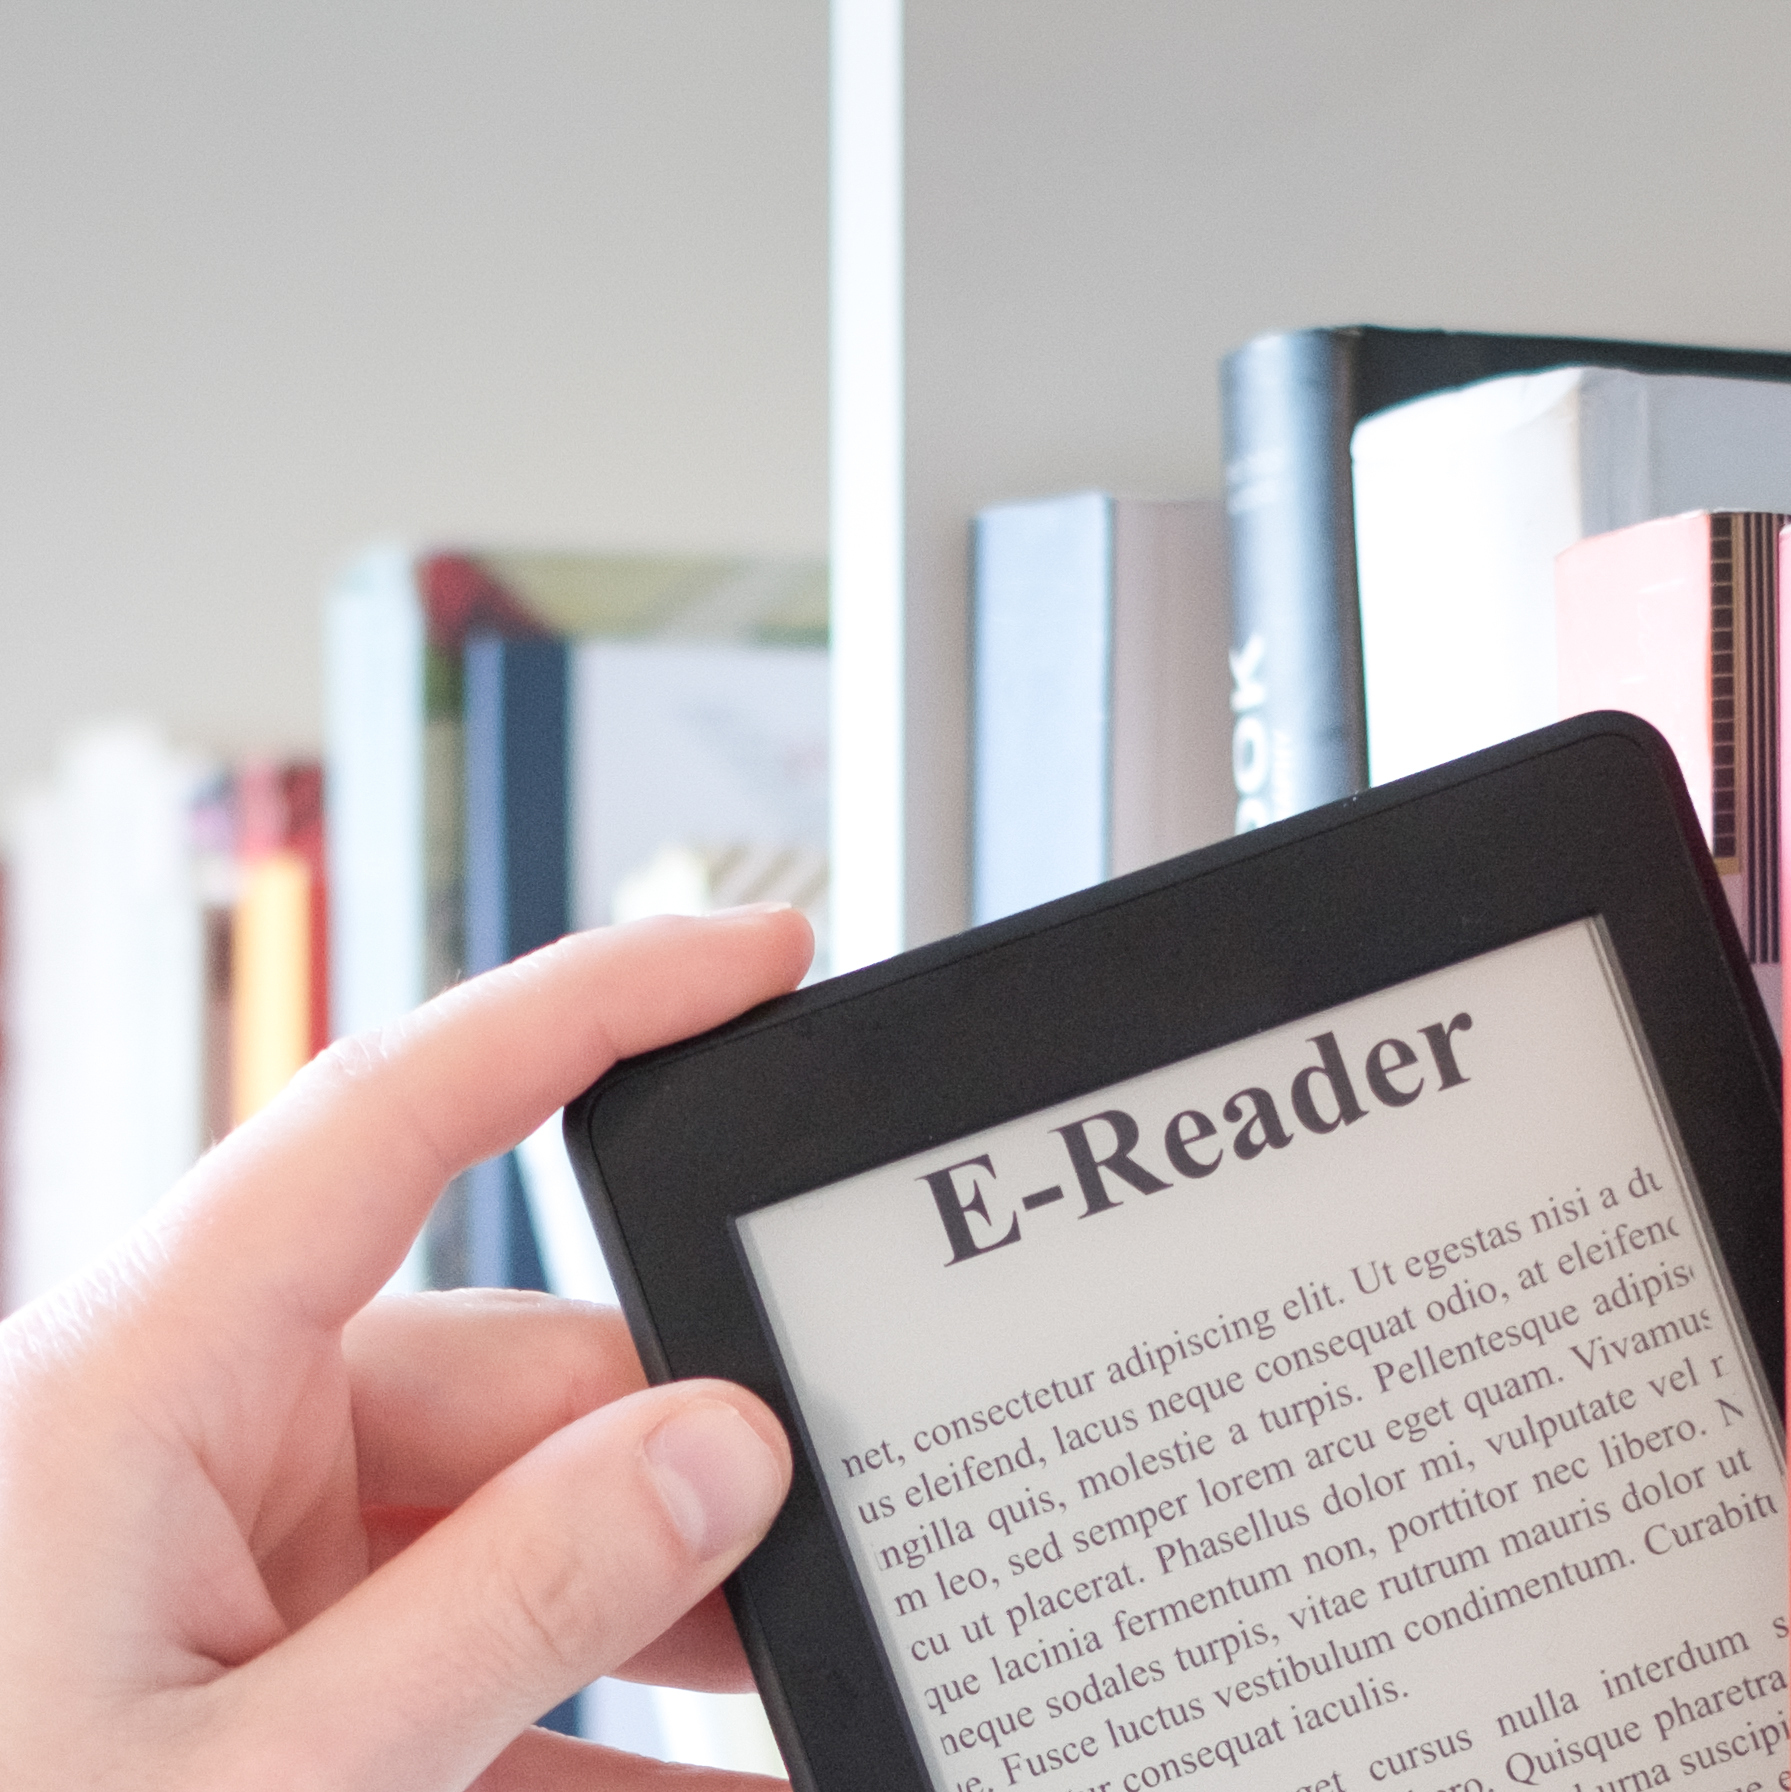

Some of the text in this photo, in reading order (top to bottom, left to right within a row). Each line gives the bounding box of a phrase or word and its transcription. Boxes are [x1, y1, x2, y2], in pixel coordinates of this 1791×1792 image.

[917, 1011, 1474, 1268] E-Reader
[857, 1495, 896, 1525] us
[905, 1436, 1047, 1508] eleifend,
[1052, 1409, 1139, 1455] lacus
[1147, 1371, 1244, 1422] neque
[1255, 1307, 1417, 1383] consequat
[1426, 1279, 1510, 1322] odio,
[1518, 1261, 1548, 1291] at
[870, 1262, 1695, 1573] ngilla quis, molestie a turpis. Pellentesque adipis
[913, 1370, 1095, 1453] consectetur
[1106, 1309, 1276, 1385] adipiscing
[1282, 1281, 1345, 1321] elit.
[1351, 1261, 1396, 1295] Ut
[1404, 1221, 1522, 1280] egestas
[1530, 1187, 1590, 1234] nisi
[1599, 1187, 1619, 1210] a
[894, 1588, 928, 1616] m
[934, 1567, 1000, 1601] leo,
[1008, 1530, 1064, 1576] sed
[1072, 1493, 1188, 1553] semper
[1197, 1458, 1295, 1507] lorem
[1305, 1429, 1376, 1471] arcu
[1385, 1398, 1454, 1443] eget
[1463, 1366, 1564, 1419] quam.
[910, 1633, 951, 1662] cu
[961, 1613, 995, 1644] ut
[1005, 1563, 1145, 1637] placerat.
[1155, 1504, 1311, 1575] Phasellus
[1322, 1468, 1406, 1516] dolor
[1419, 1440, 1475, 1482] mi,
[1485, 1388, 1636, 1455] vulputate
[1648, 1357, 1699, 1398] vel
[924, 1673, 980, 1716] que
[990, 1627, 1103, 1685] lacinia
[1114, 1563, 1292, 1642] fermentum
[1303, 1537, 1377, 1575] non,
[1387, 1480, 1518, 1554] porttitor
[1532, 1457, 1589, 1494] nec
[1599, 1420, 1706, 1469] libero.
[940, 1448, 1752, 1756] neque sodales turpis, vitae rutrum mauris dolor ut
[1001, 1735, 1099, 1786] Fusce
[1105, 1698, 1205, 1748] luctus
[1213, 1631, 1395, 1708] vestibulum
[1403, 1548, 1635, 1643] condimentum.
[1290, 1677, 1409, 1735] iaculis.
[1369, 1729, 1473, 1782] cursus
[1496, 1689, 1580, 1737] nulla
[1600, 1631, 1750, 1699] interdum
[1505, 1721, 1642, 1786] Quisque
[1653, 1670, 1786, 1741] pharetra
